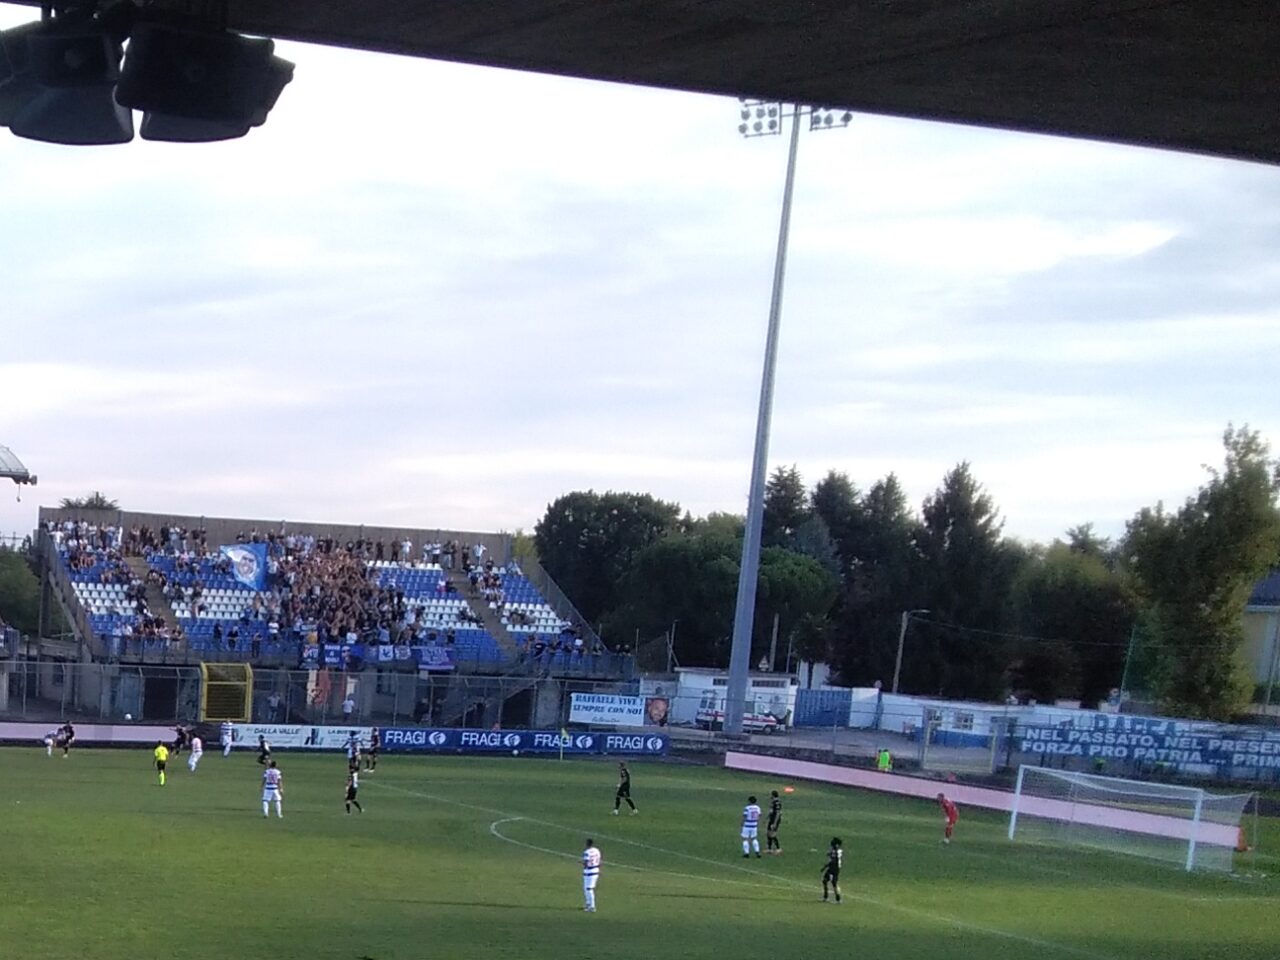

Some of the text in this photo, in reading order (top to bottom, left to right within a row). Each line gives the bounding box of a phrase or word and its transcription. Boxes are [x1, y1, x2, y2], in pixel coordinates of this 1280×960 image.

[575, 694, 615, 704] RAFFAELE
[573, 704, 605, 713] SEMPRE
[607, 706, 624, 714] CON
[254, 727, 277, 735] DALLA
[279, 728, 301, 736] VALLE
[385, 730, 426, 745] FRAGI
[461, 732, 501, 746] FRAGI
[534, 733, 573, 748] FRAGI
[606, 735, 644, 749] FRAGI
[1026, 728, 1063, 742] NEL
[1068, 731, 1159, 748] PASSATO,
[1164, 736, 1203, 750] NEL
[1021, 740, 1084, 755] FORZA
[1089, 744, 1129, 758] PRO
[1133, 747, 1203, 763] PATRIA
